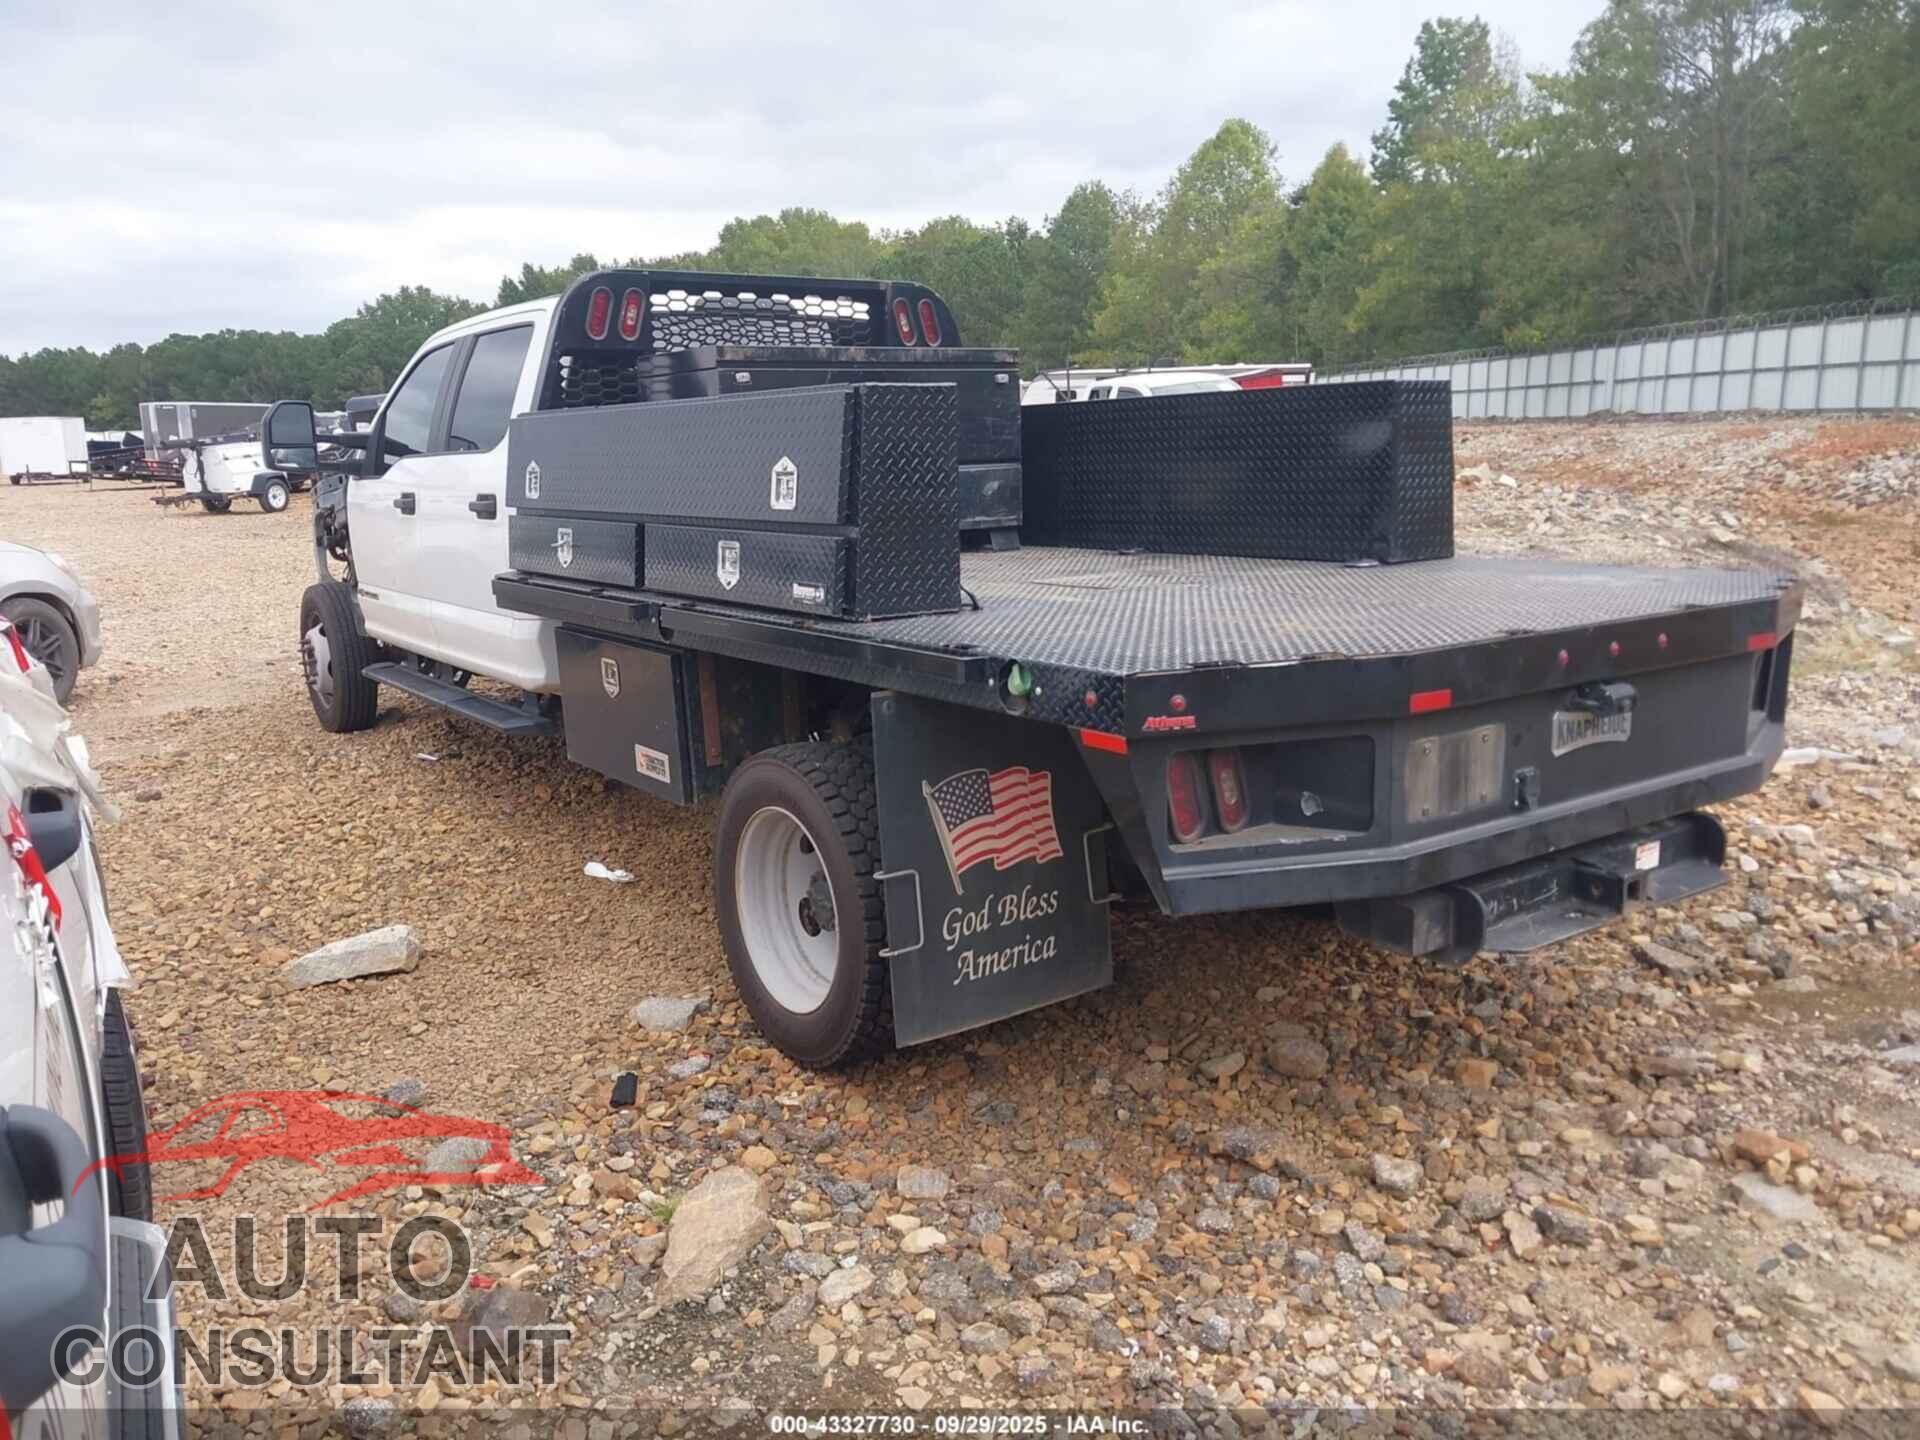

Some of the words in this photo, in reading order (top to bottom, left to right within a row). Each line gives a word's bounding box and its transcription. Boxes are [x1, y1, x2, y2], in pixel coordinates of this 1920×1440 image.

[942, 893, 994, 952] God
[997, 884, 1059, 926] Bless
[953, 933, 1057, 985] America
